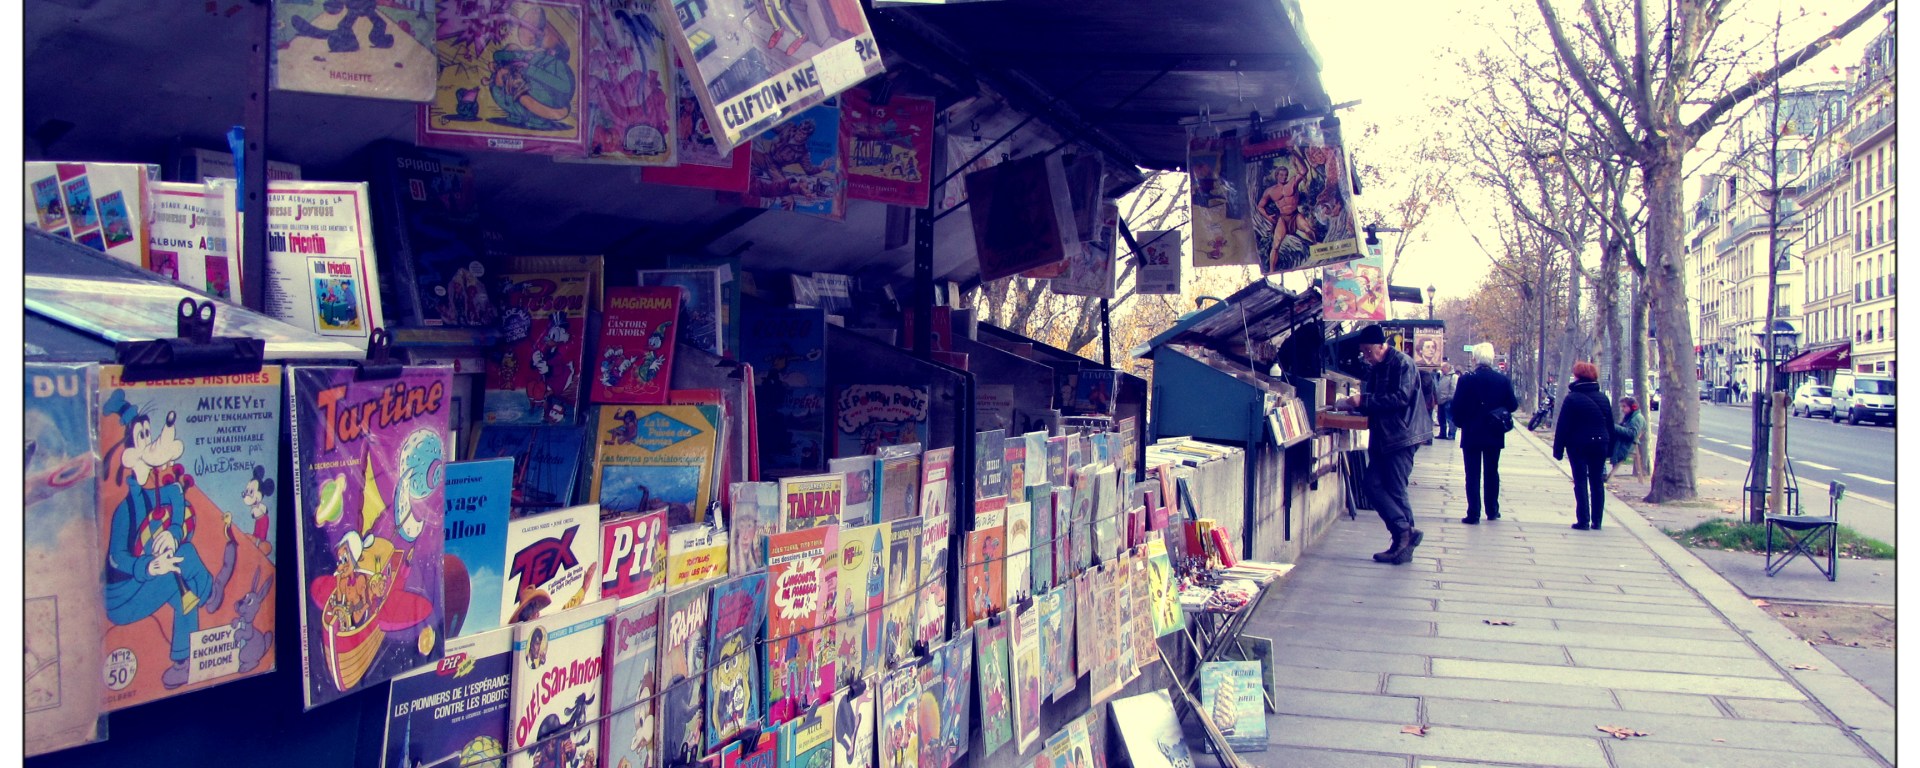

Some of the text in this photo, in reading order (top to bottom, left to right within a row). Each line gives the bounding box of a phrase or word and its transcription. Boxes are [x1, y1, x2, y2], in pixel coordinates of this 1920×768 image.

[329, 70, 373, 83] HACHETTE
[722, 81, 787, 130] CLIFTON
[791, 65, 819, 93] NE
[396, 156, 440, 174] SPIROU
[411, 180, 425, 199] 91
[269, 194, 343, 206] EAUX ALBUMS DE LA
[150, 237, 193, 249] ALBUMS
[606, 328, 646, 337] JUNIORS
[607, 320, 648, 329] CASTORS
[33, 374, 80, 398] DU
[145, 375, 196, 386] BELLES
[202, 372, 270, 385] HISTOIRES
[196, 395, 266, 412] MICKEY ET
[852, 390, 891, 407] POMPON
[893, 392, 926, 411] ROUGE
[185, 411, 273, 424] GOUFY L'ENCHANTEUR
[317, 379, 445, 451] Tartine
[216, 425, 248, 434] MICKEY
[195, 436, 206, 446] ET
[210, 445, 242, 455] VOLEUR
[444, 475, 483, 486] amorisse
[444, 494, 488, 517] yage
[787, 489, 841, 520] TARZAN
[443, 520, 487, 541] allon
[602, 516, 661, 583] Pif
[508, 523, 581, 605] TEX
[771, 557, 781, 565] Les
[781, 553, 801, 563] dossiers
[668, 592, 709, 653] RAHAN
[201, 629, 232, 645] GOUFY
[192, 639, 240, 659] ENCHANTEUR
[199, 652, 233, 671] DIPLOMÉ
[440, 655, 462, 672] Pif
[107, 668, 128, 688] 50
[394, 674, 511, 718] LES PIONNIERS DE L'ESPÉRANCE
[433, 687, 510, 720] CONTRE LES ROBOTS
[806, 721, 823, 736] ALICE
